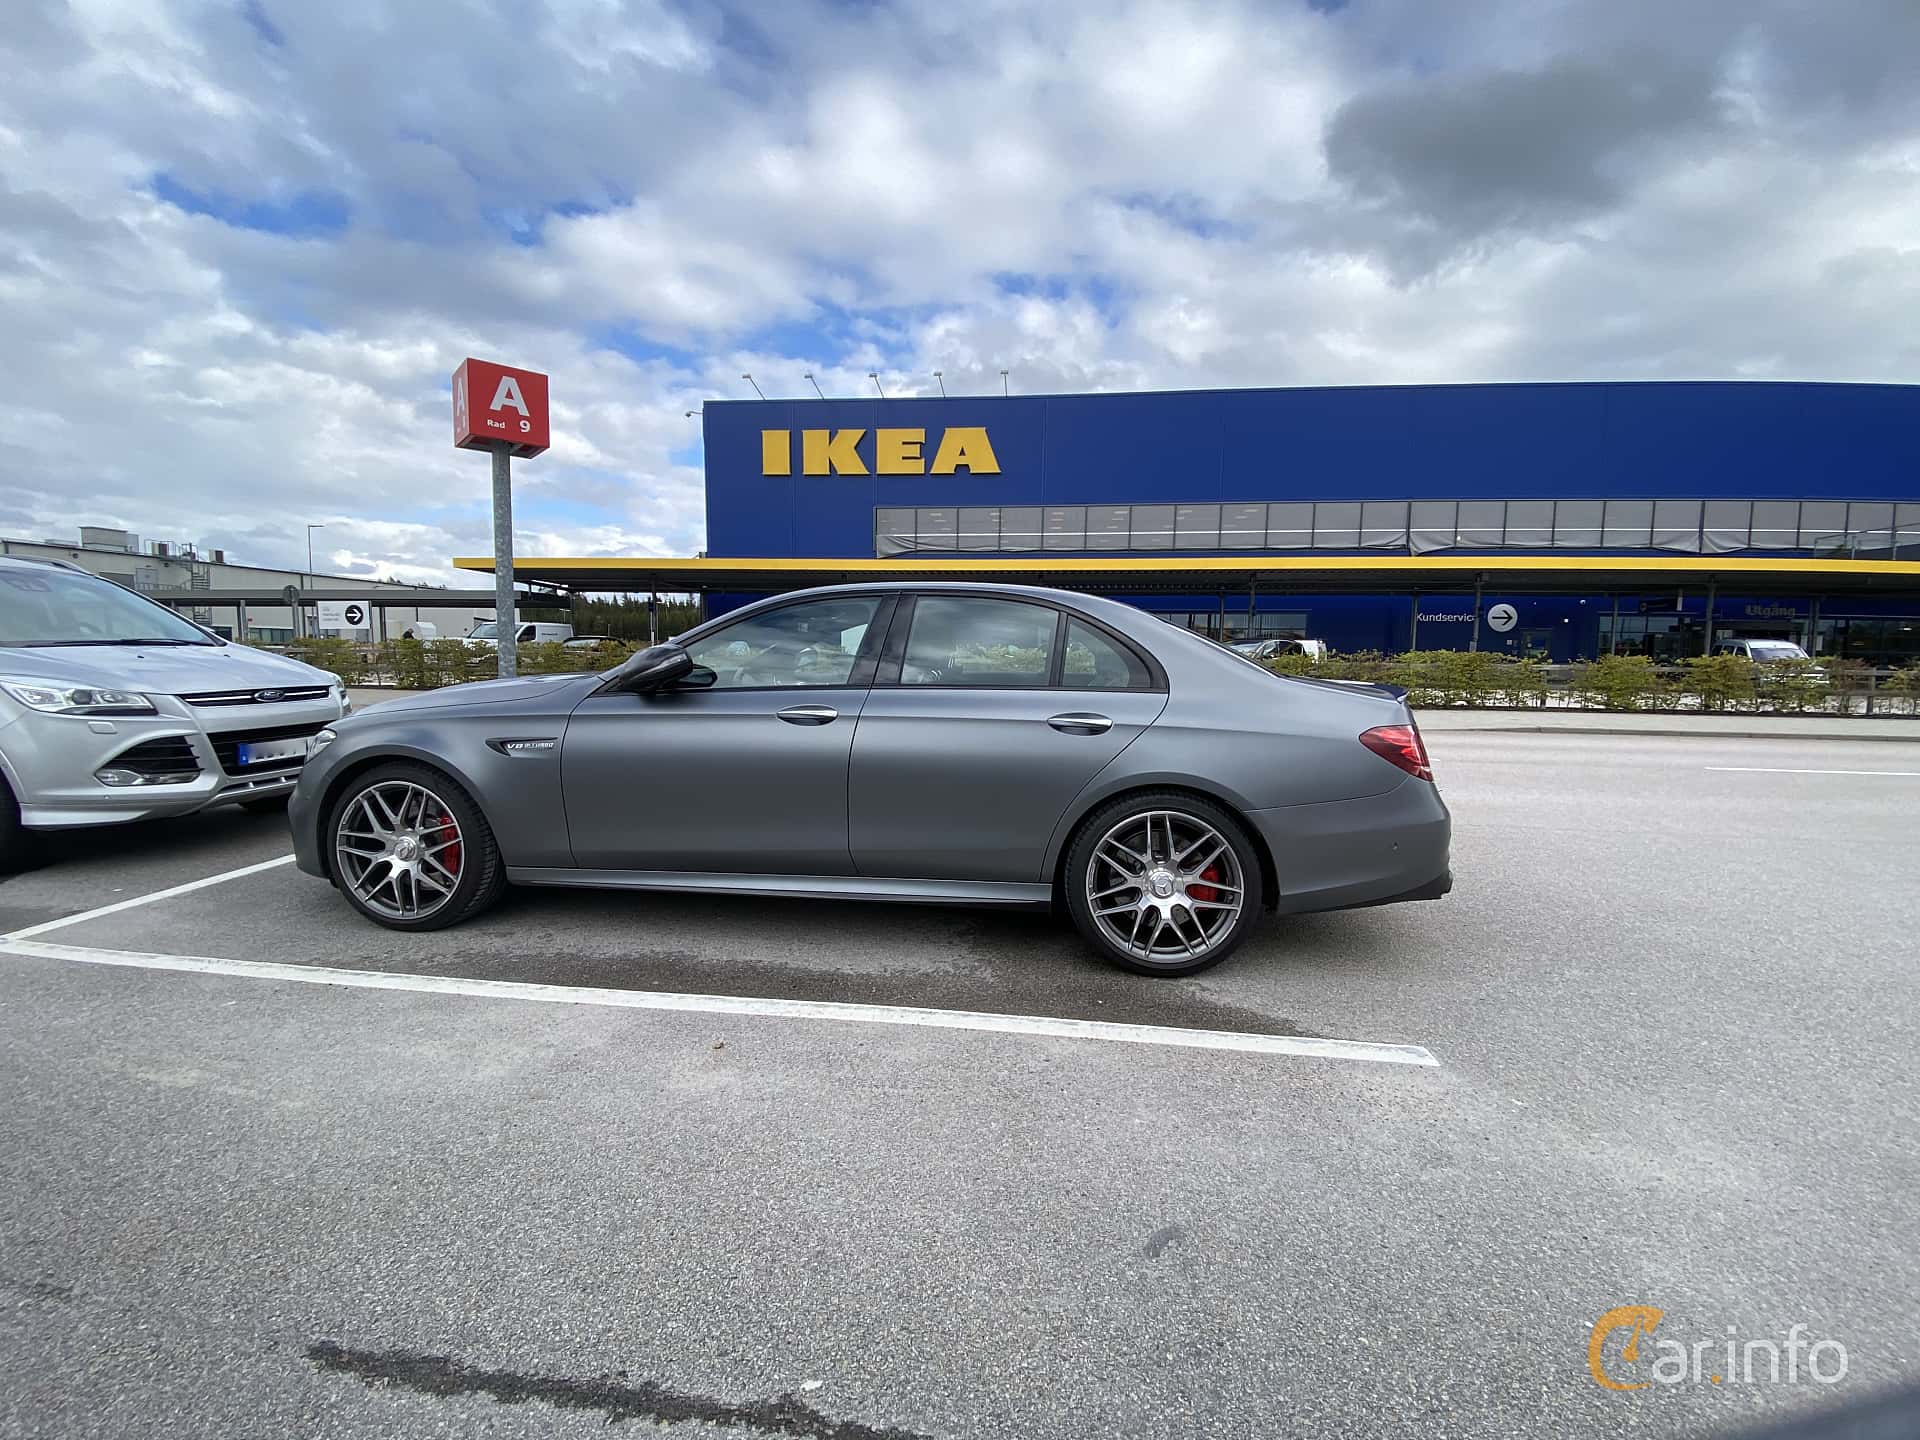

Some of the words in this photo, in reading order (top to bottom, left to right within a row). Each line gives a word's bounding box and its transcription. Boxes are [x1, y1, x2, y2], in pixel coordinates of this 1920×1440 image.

[489, 375, 530, 417] A
[487, 419, 505, 429] Rad
[519, 420, 531, 432] 9
[761, 427, 1001, 475] IKEA
[1416, 612, 1475, 622] Kundservic
